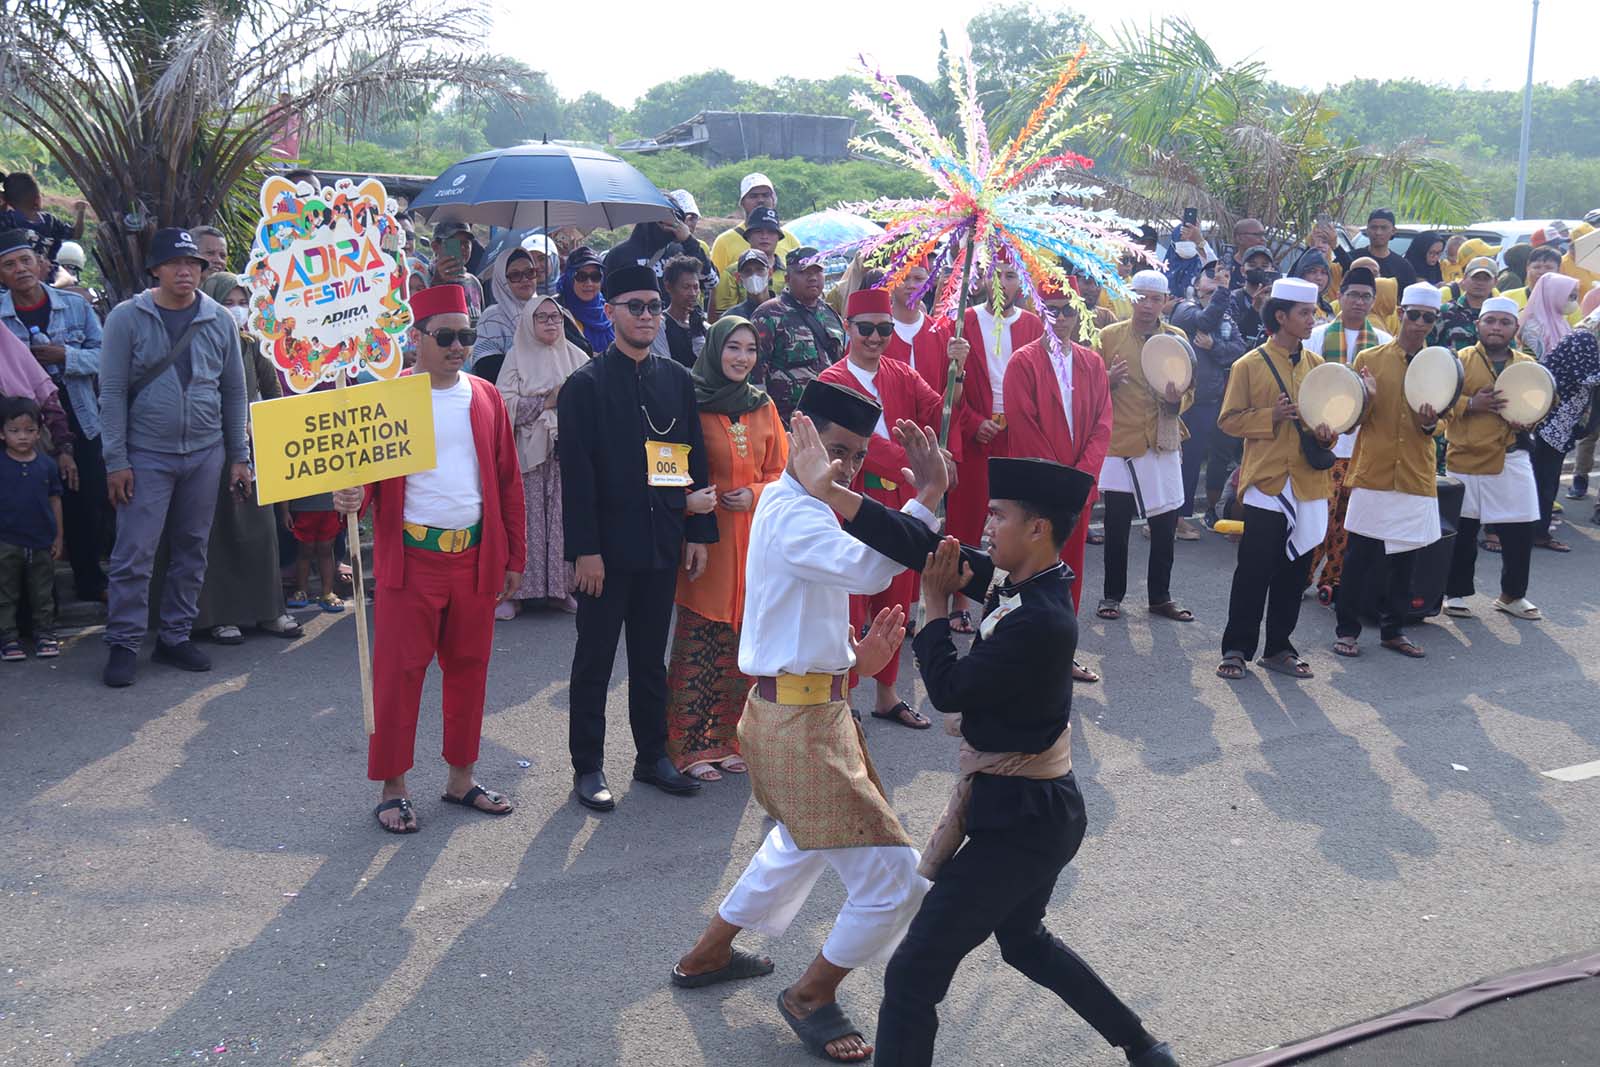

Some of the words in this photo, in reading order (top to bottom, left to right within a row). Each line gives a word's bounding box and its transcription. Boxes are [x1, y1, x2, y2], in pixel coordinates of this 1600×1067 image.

[321, 304, 369, 326] ADIRA
[305, 402, 387, 433] SENTRA
[284, 419, 409, 458] OPERATION
[285, 439, 412, 481] JABOTABEK
[656, 461, 677, 474] 006
